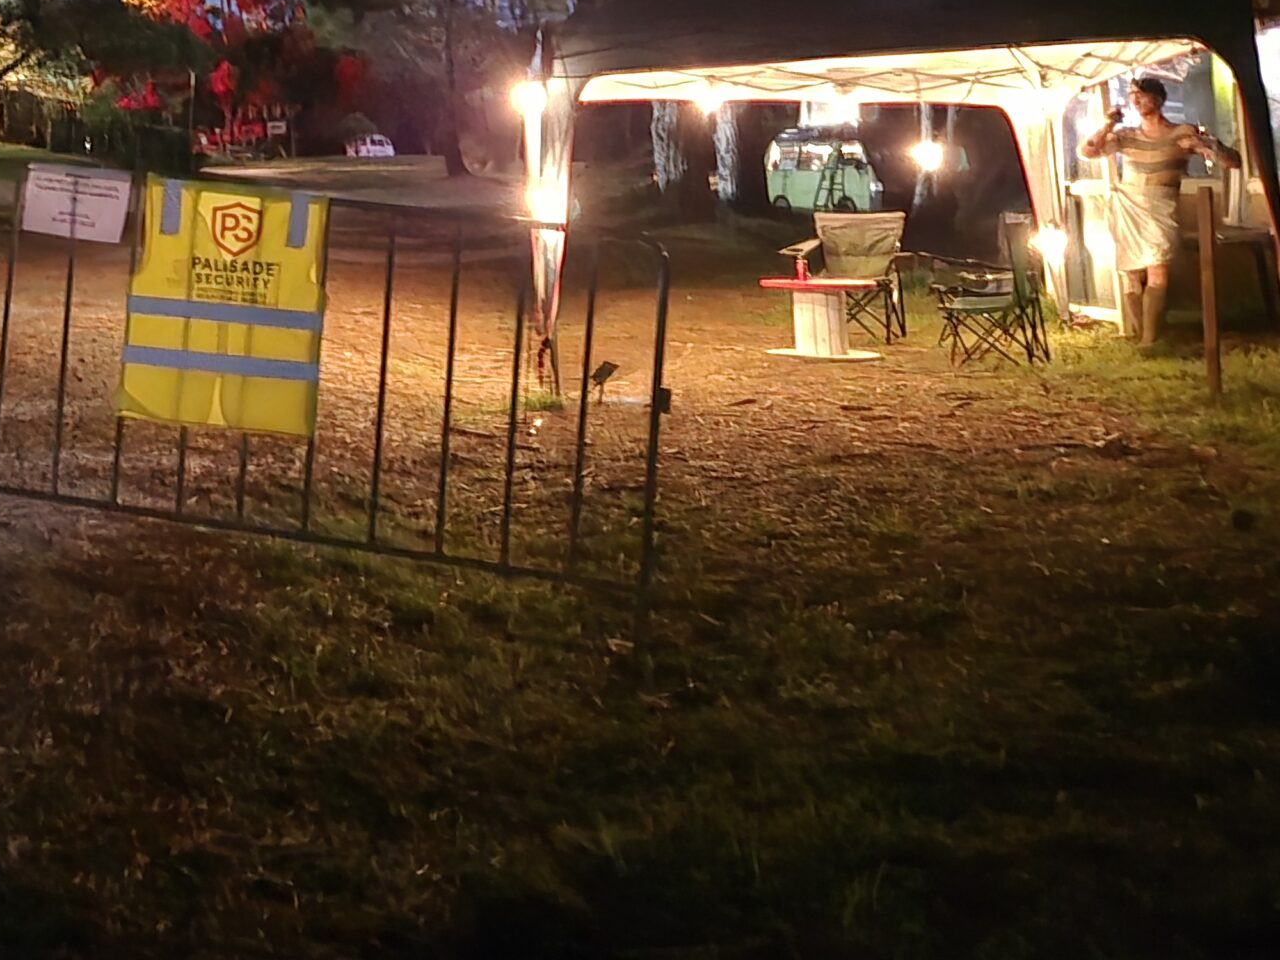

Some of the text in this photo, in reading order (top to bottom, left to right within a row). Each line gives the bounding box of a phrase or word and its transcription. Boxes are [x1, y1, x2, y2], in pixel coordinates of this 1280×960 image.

[221, 213, 253, 243] PS
[192, 257, 275, 277] PALISADE
[195, 273, 271, 289] SECURITY
